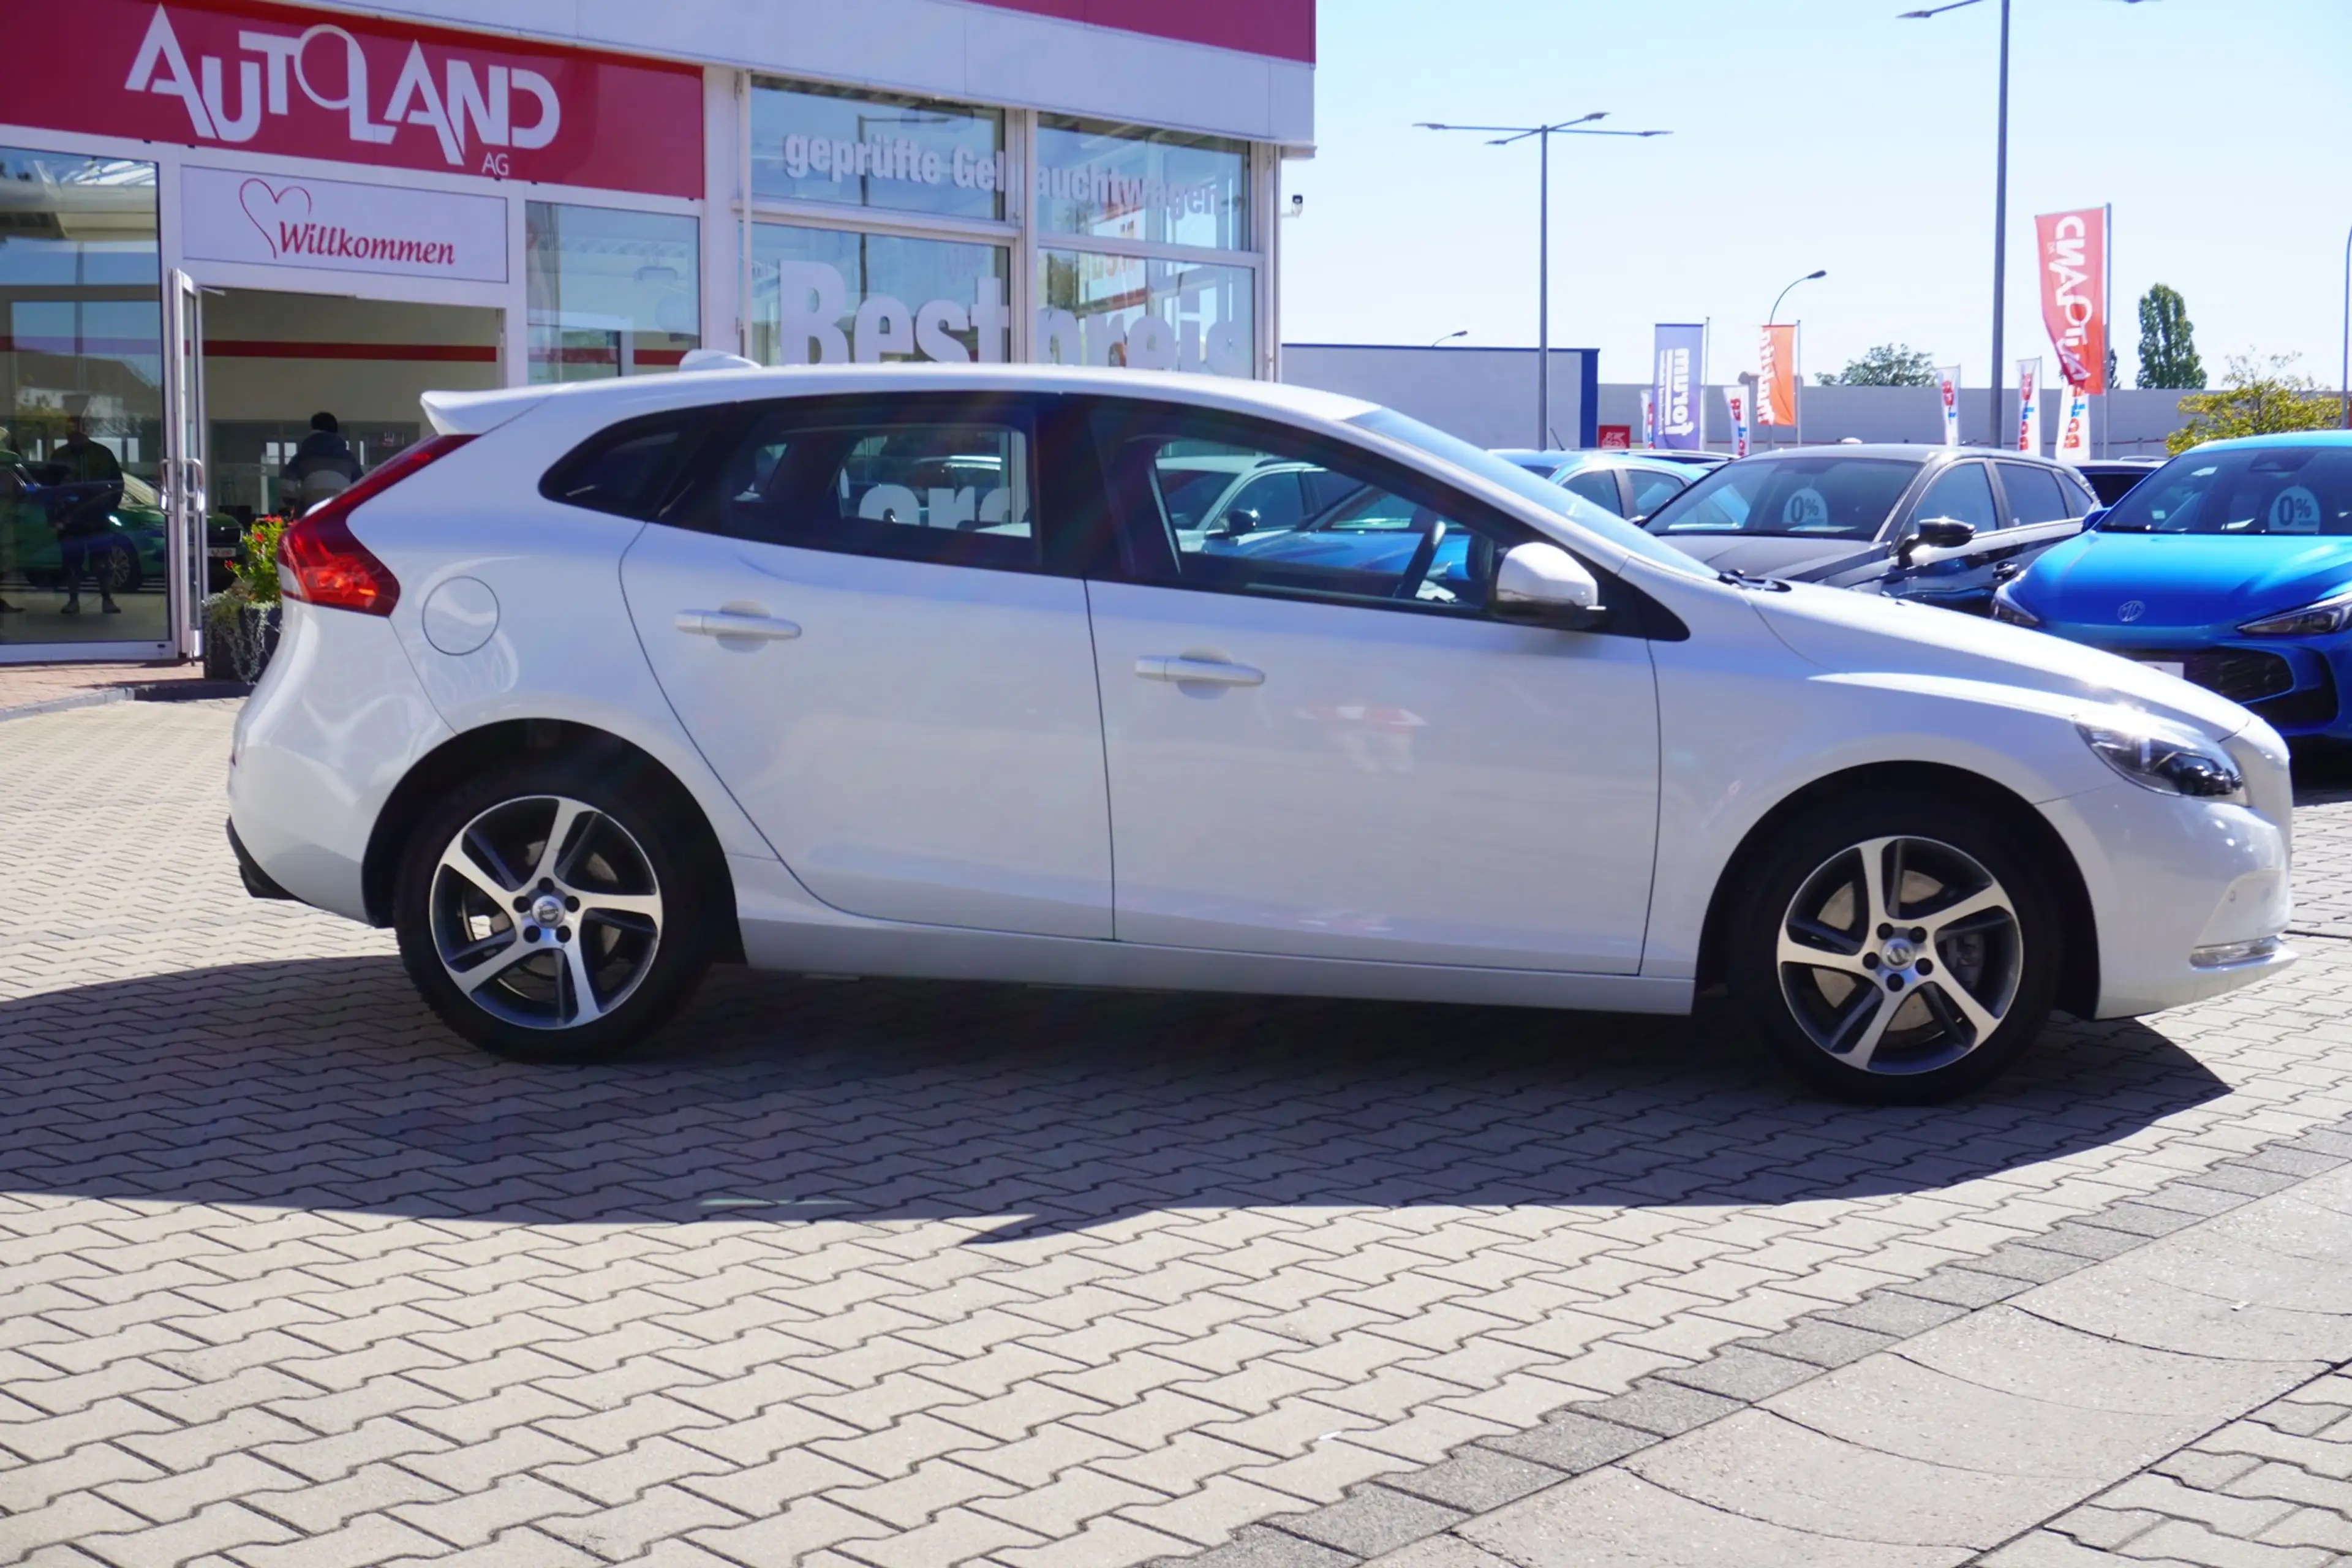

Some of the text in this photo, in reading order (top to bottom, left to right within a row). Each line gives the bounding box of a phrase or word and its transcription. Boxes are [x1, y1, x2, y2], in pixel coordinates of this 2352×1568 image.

[481, 152, 508, 176] AG
[785, 134, 1222, 221] geprüfte Geauchtwagen
[279, 221, 454, 265] Willkommen
[779, 260, 1009, 366] Best
[1790, 495, 1819, 522] 0%
[2277, 495, 2312, 526] 0%
